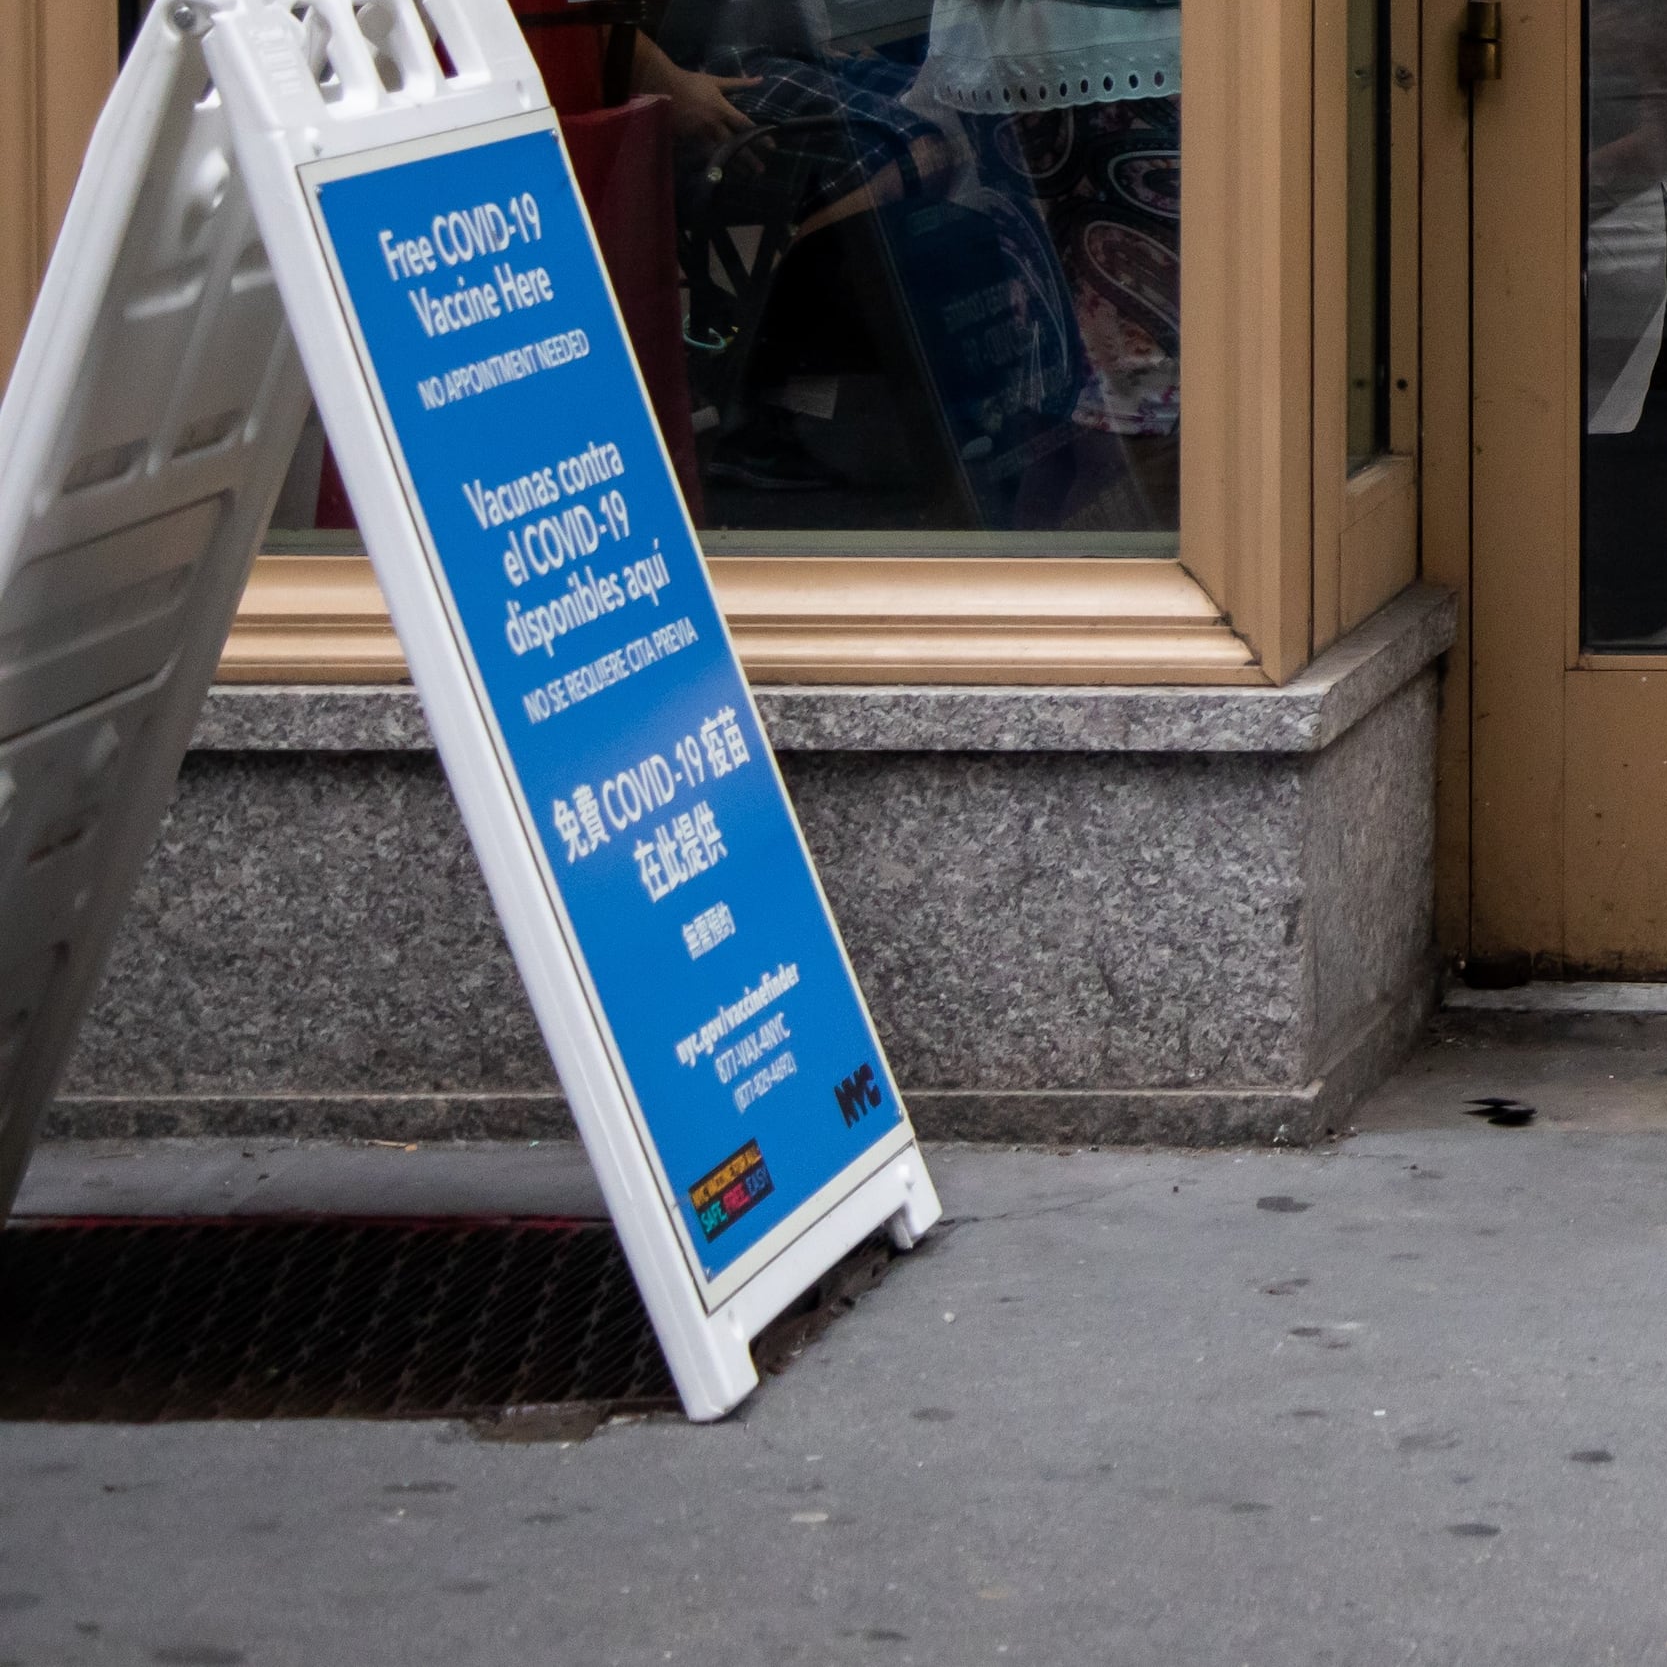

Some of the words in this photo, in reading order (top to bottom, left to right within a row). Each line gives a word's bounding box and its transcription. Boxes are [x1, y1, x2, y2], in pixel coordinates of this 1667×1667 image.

[378, 228, 437, 282] Free
[432, 191, 542, 267] COVID-19
[408, 274, 502, 338] Vaccine
[494, 262, 555, 313] Here
[417, 374, 446, 411] NO
[445, 343, 538, 403] APPOINTMENT
[534, 328, 591, 374] NEEDED
[462, 466, 561, 531] Vacunas
[557, 440, 625, 496] contra
[503, 530, 531, 587] el
[523, 489, 631, 576] COVID-19
[504, 565, 626, 658] disponibles
[623, 537, 671, 607] aquí
[553, 783, 611, 865] 免費
[602, 734, 705, 831] COVID-19
[700, 705, 752, 779] 疫苗
[632, 799, 729, 903] 在此提供
[833, 1062, 883, 1129] NYC
